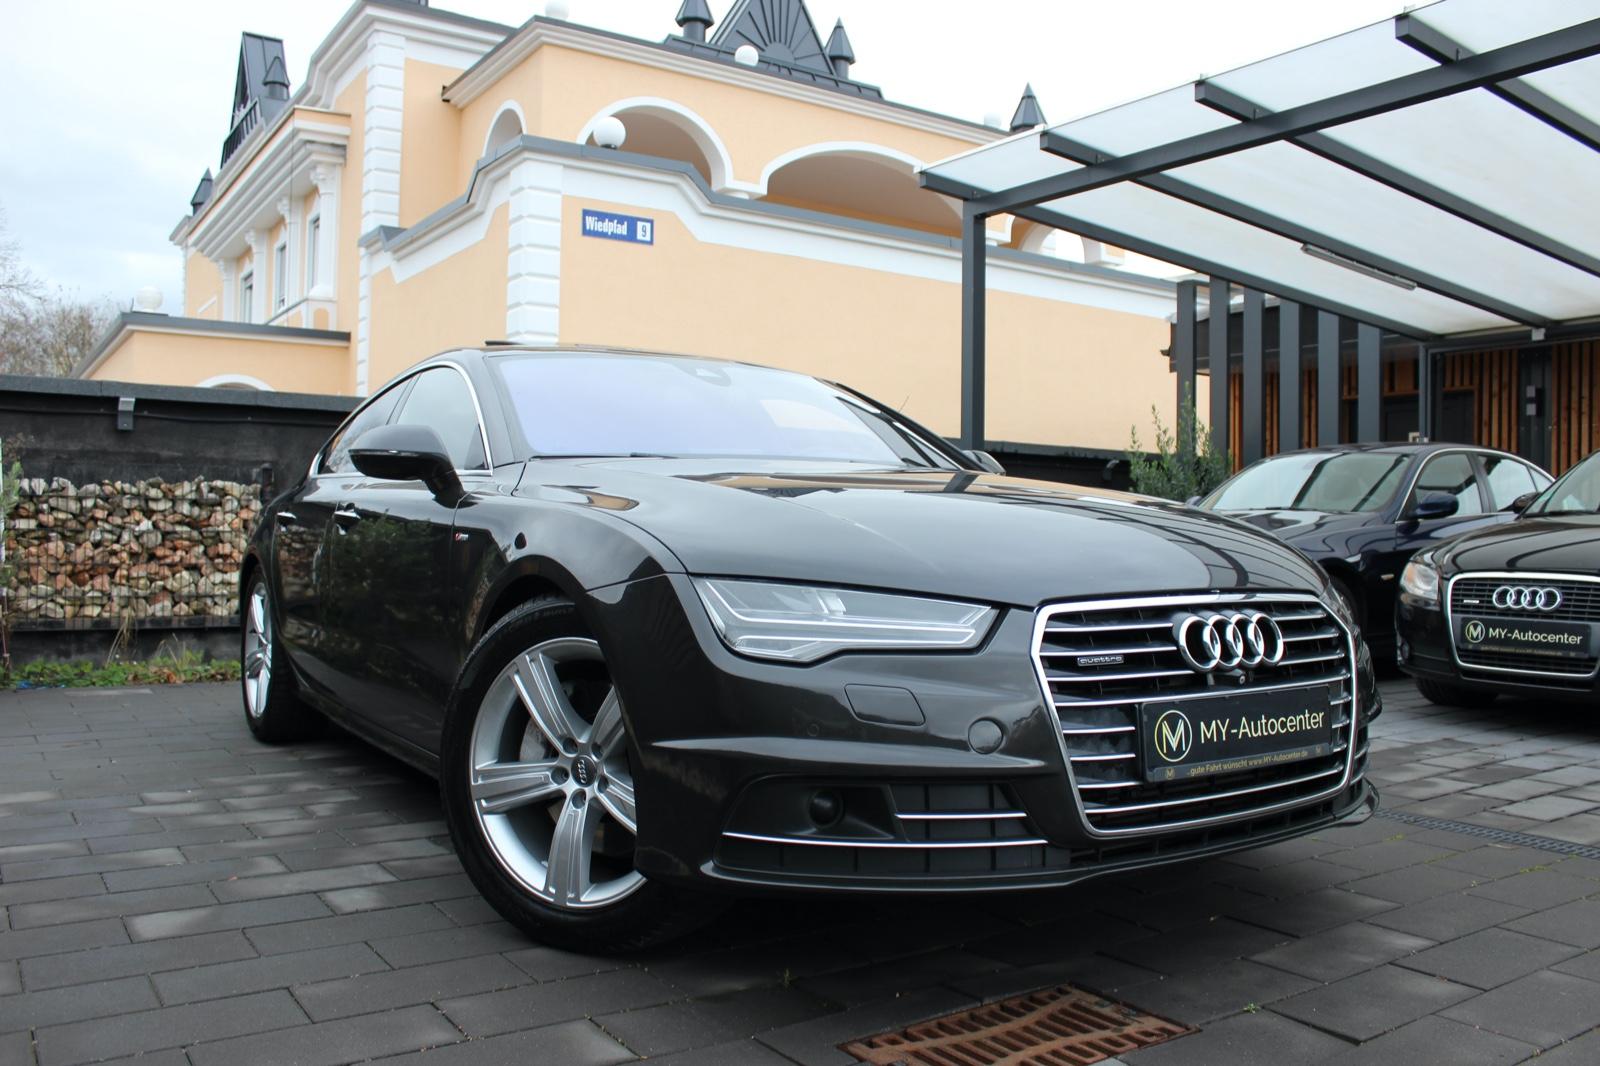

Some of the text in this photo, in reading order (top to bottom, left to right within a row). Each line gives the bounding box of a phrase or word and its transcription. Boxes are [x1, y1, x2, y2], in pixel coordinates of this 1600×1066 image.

[586, 216, 647, 237] Wiedpfad 9
[1488, 627, 1583, 644] MY-Autocenter
[1080, 656, 1122, 664] quattro
[1162, 719, 1186, 753] M
[1200, 709, 1325, 744] MY-Autocenter
[1206, 763, 1221, 772] Fahrt
